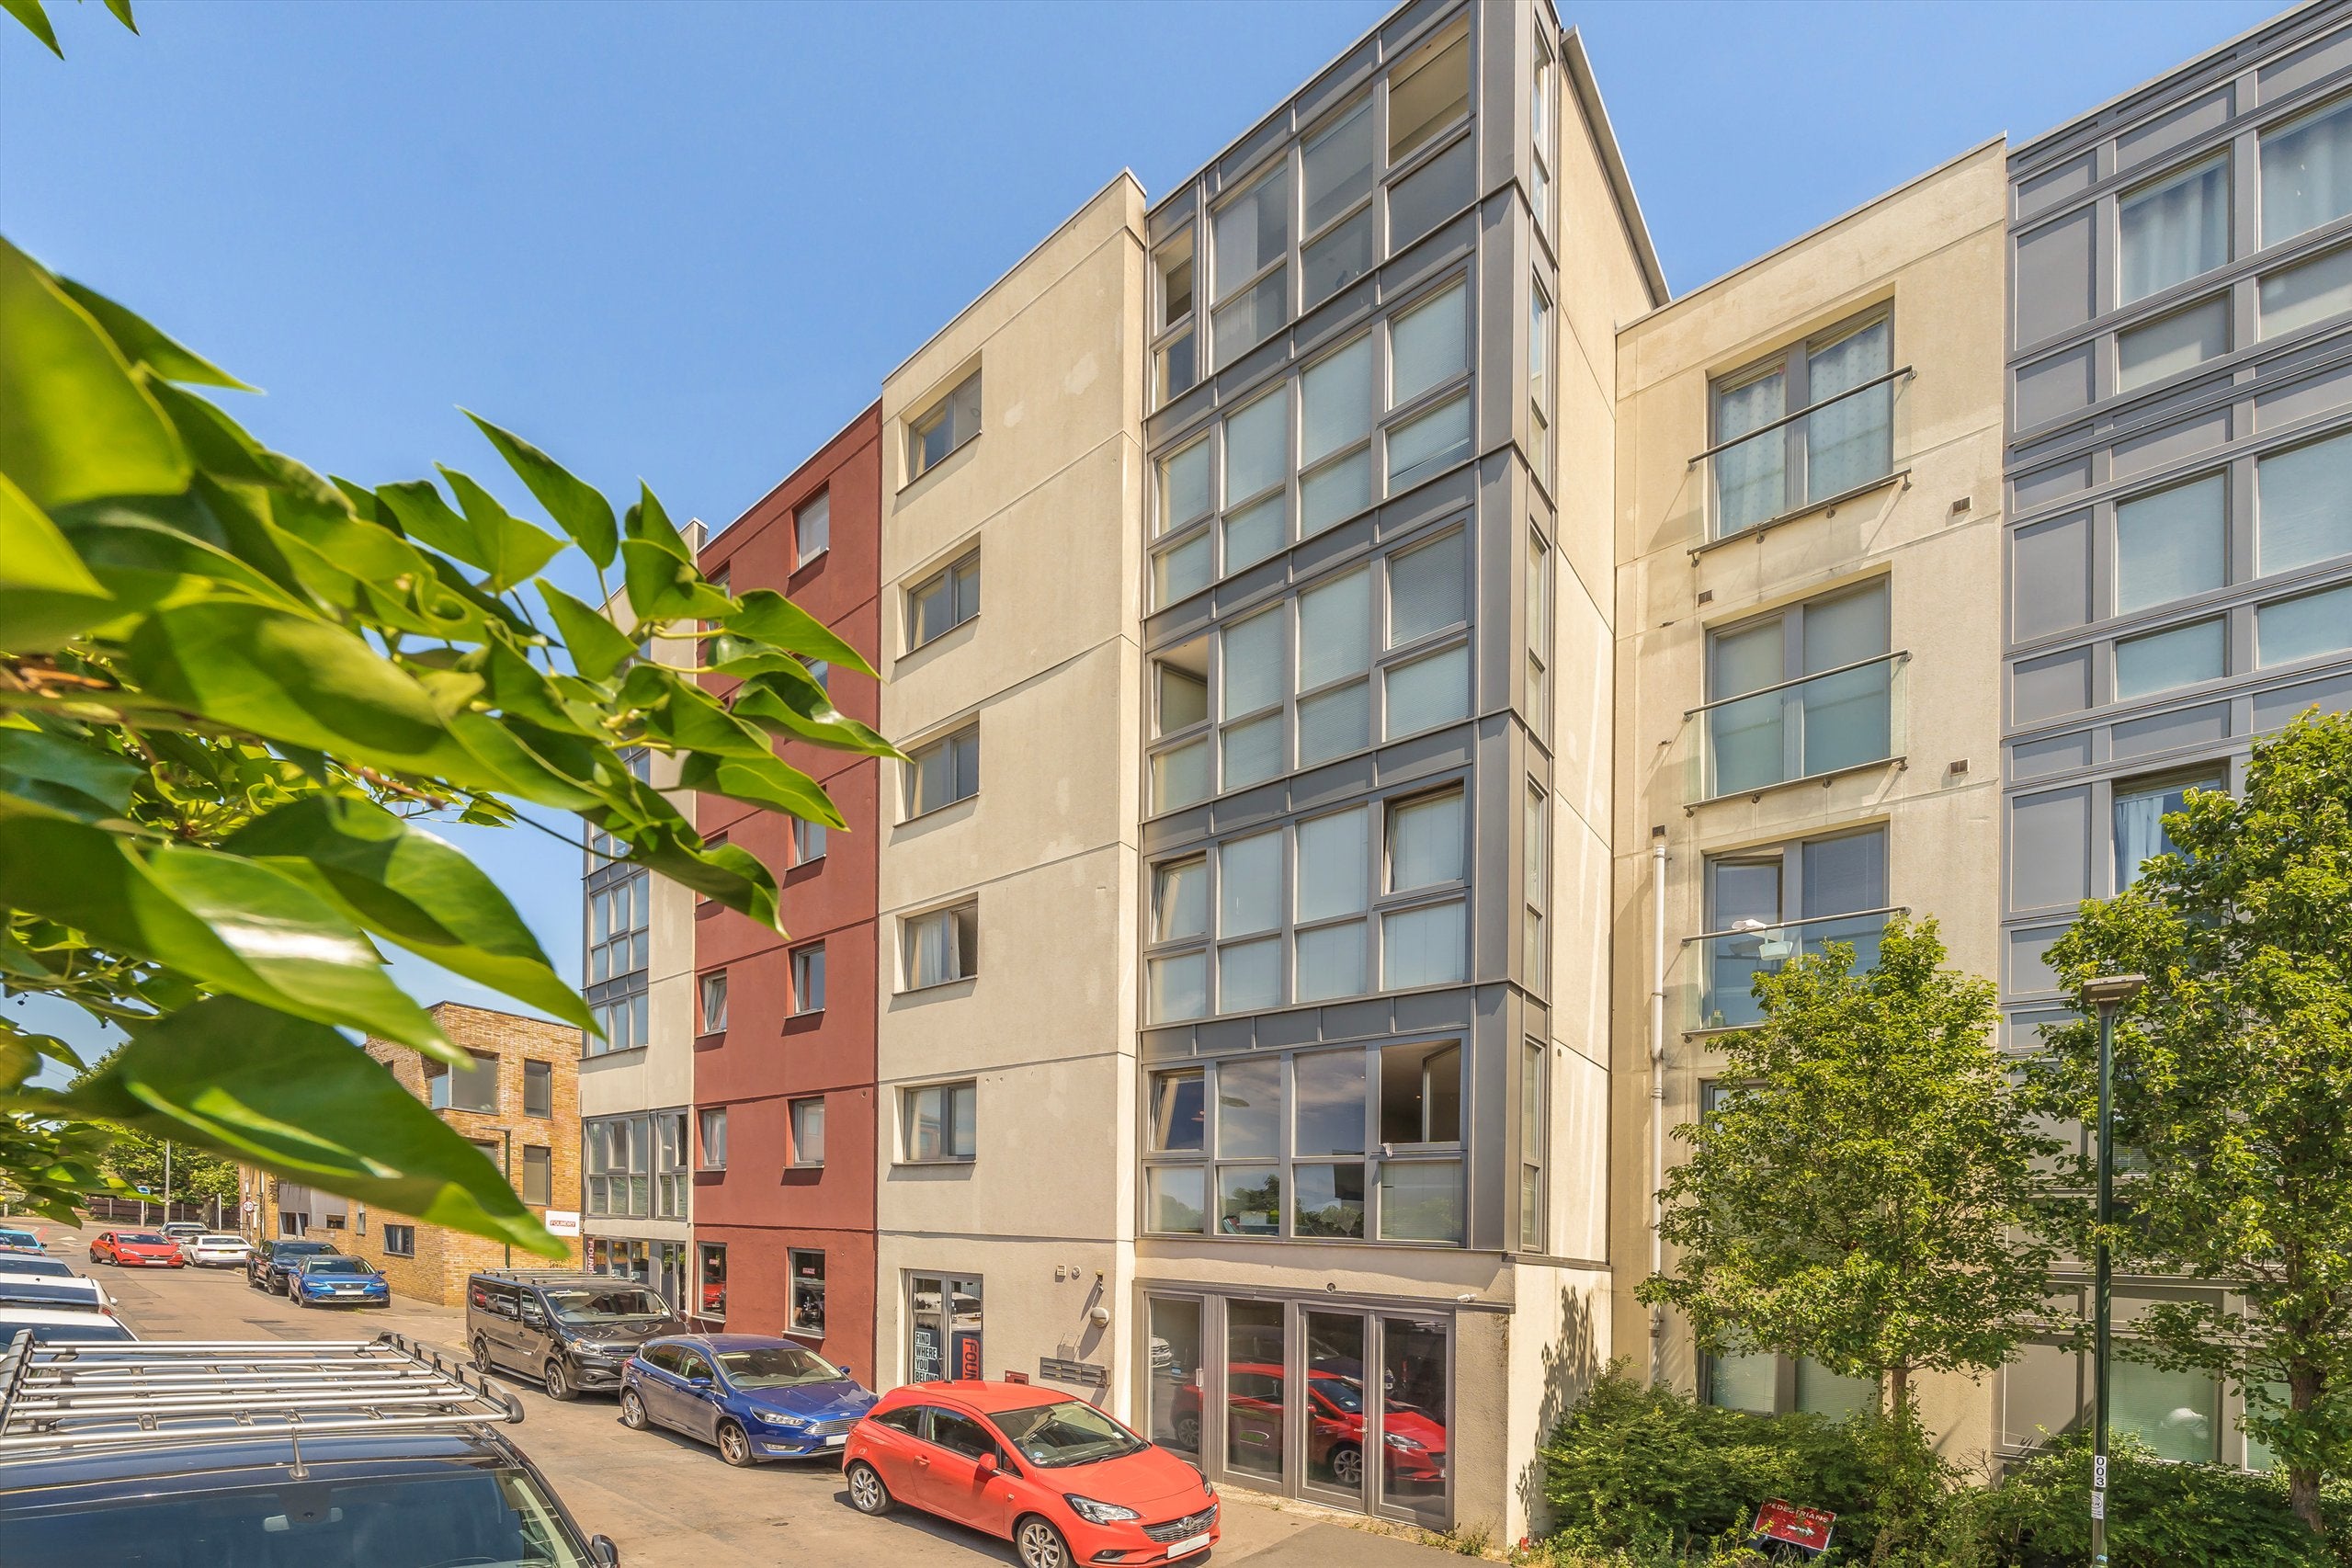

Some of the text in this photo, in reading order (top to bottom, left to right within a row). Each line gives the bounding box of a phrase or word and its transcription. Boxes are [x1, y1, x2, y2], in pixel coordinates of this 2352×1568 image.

[916, 1333, 929, 1344] FIND
[916, 1346, 937, 1359] WHERE
[915, 1358, 928, 1370] YOU
